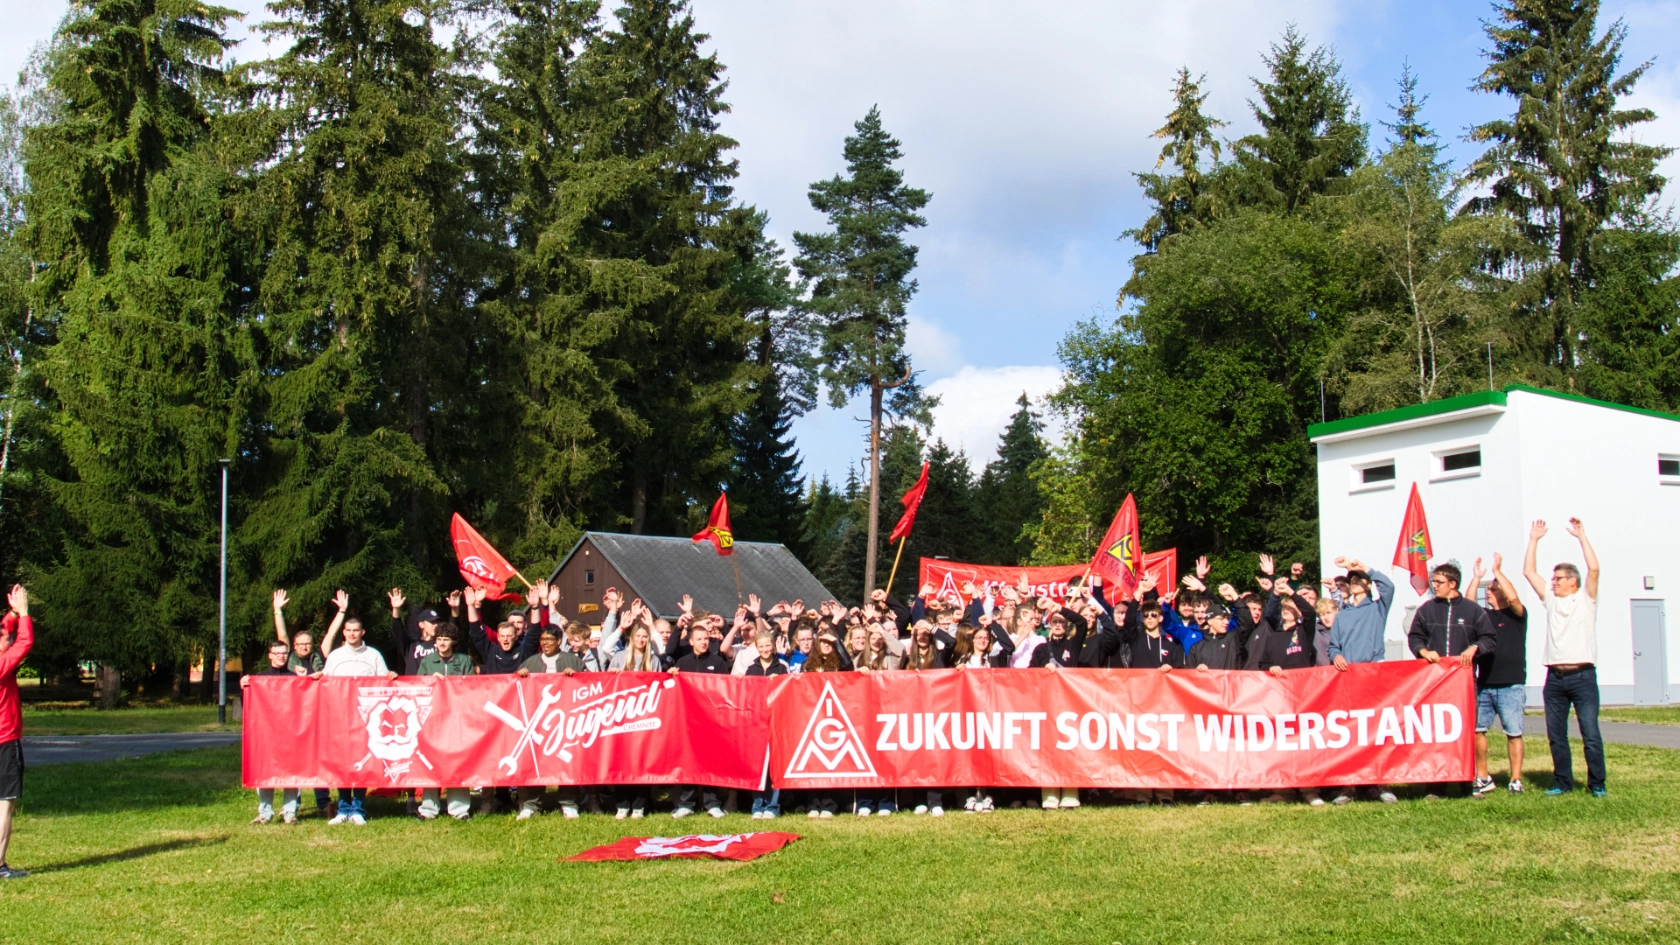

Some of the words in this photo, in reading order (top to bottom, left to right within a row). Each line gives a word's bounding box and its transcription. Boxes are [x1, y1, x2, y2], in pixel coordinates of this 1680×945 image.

[572, 681, 603, 703] IGM
[542, 680, 662, 756] Jugend
[623, 721, 656, 731] CHEMNITZ
[876, 711, 1047, 751] ZUKUNFT
[1055, 711, 1185, 752] SONST
[1193, 703, 1463, 752] WIDERSTAND
